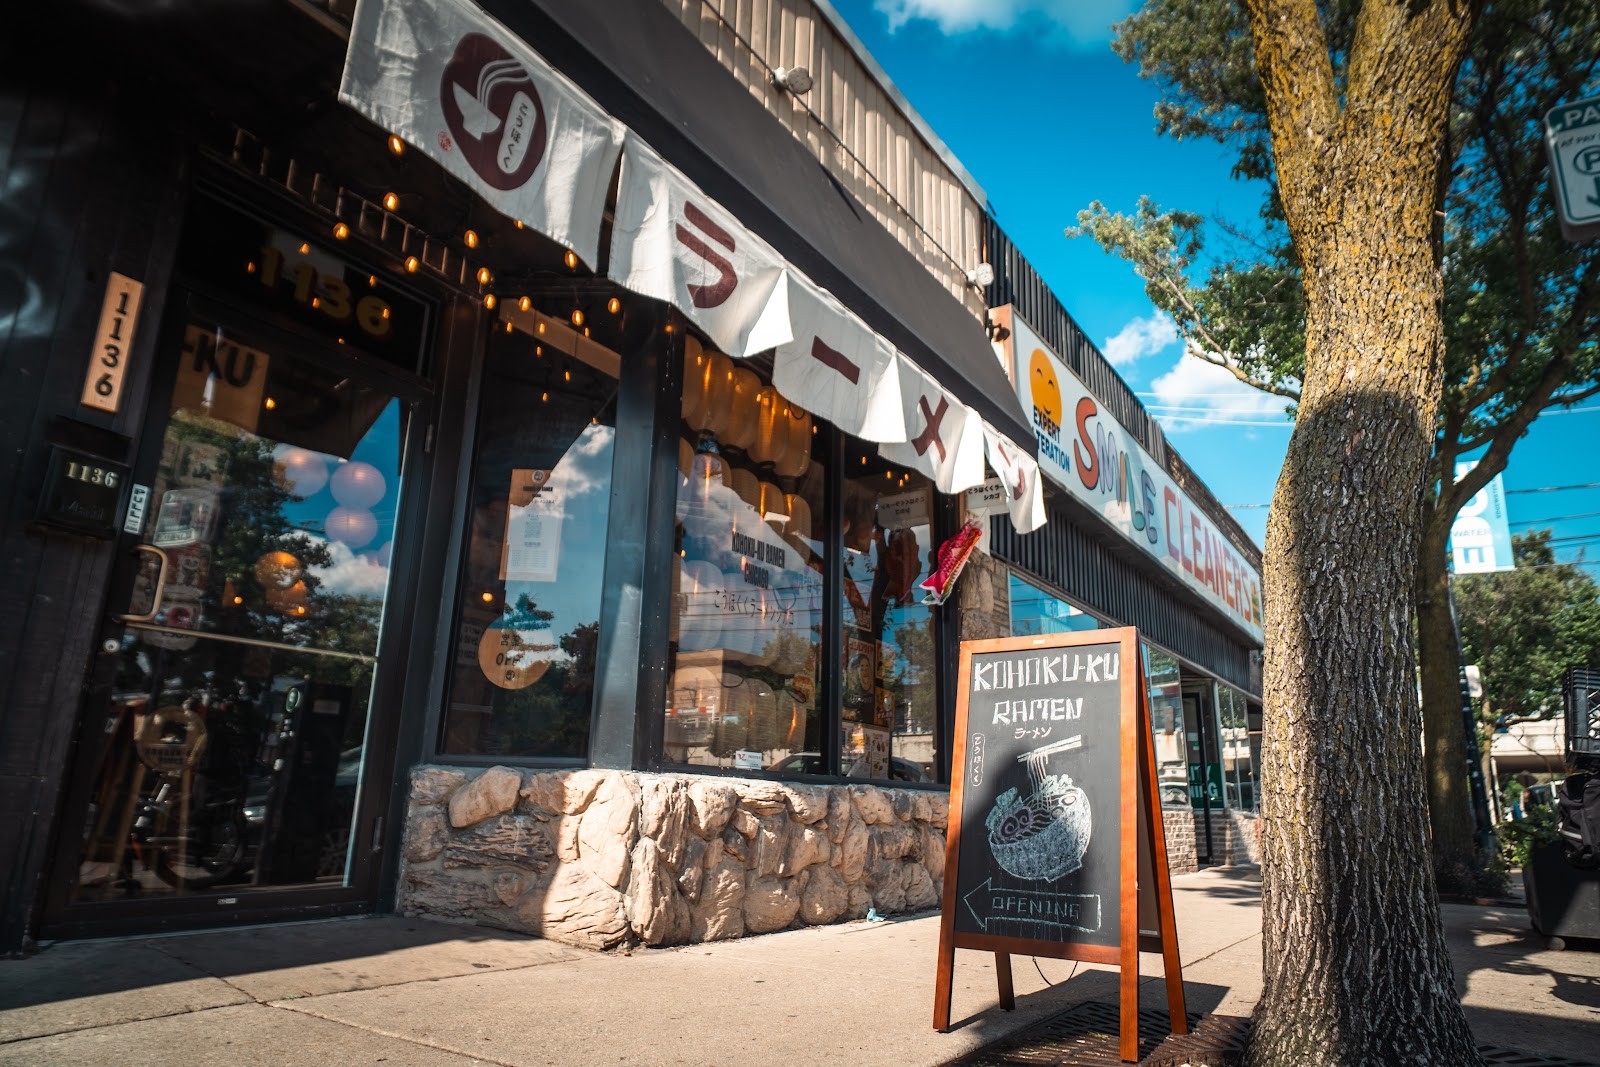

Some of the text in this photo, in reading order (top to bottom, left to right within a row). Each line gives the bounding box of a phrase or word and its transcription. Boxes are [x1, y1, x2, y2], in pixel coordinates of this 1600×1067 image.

[1564, 106, 1600, 127] PA
[259, 246, 393, 336] 1136
[95, 291, 129, 396] 1136
[1033, 405, 1061, 443] EXPERT
[1031, 427, 1070, 473] TERATION
[67, 461, 118, 488] 1136
[1074, 396, 1252, 623] SMILE CLEANERS
[973, 652, 1119, 692] KOHOKU-KU
[992, 697, 1084, 725] RAMEN
[992, 896, 1081, 920] OPENING
